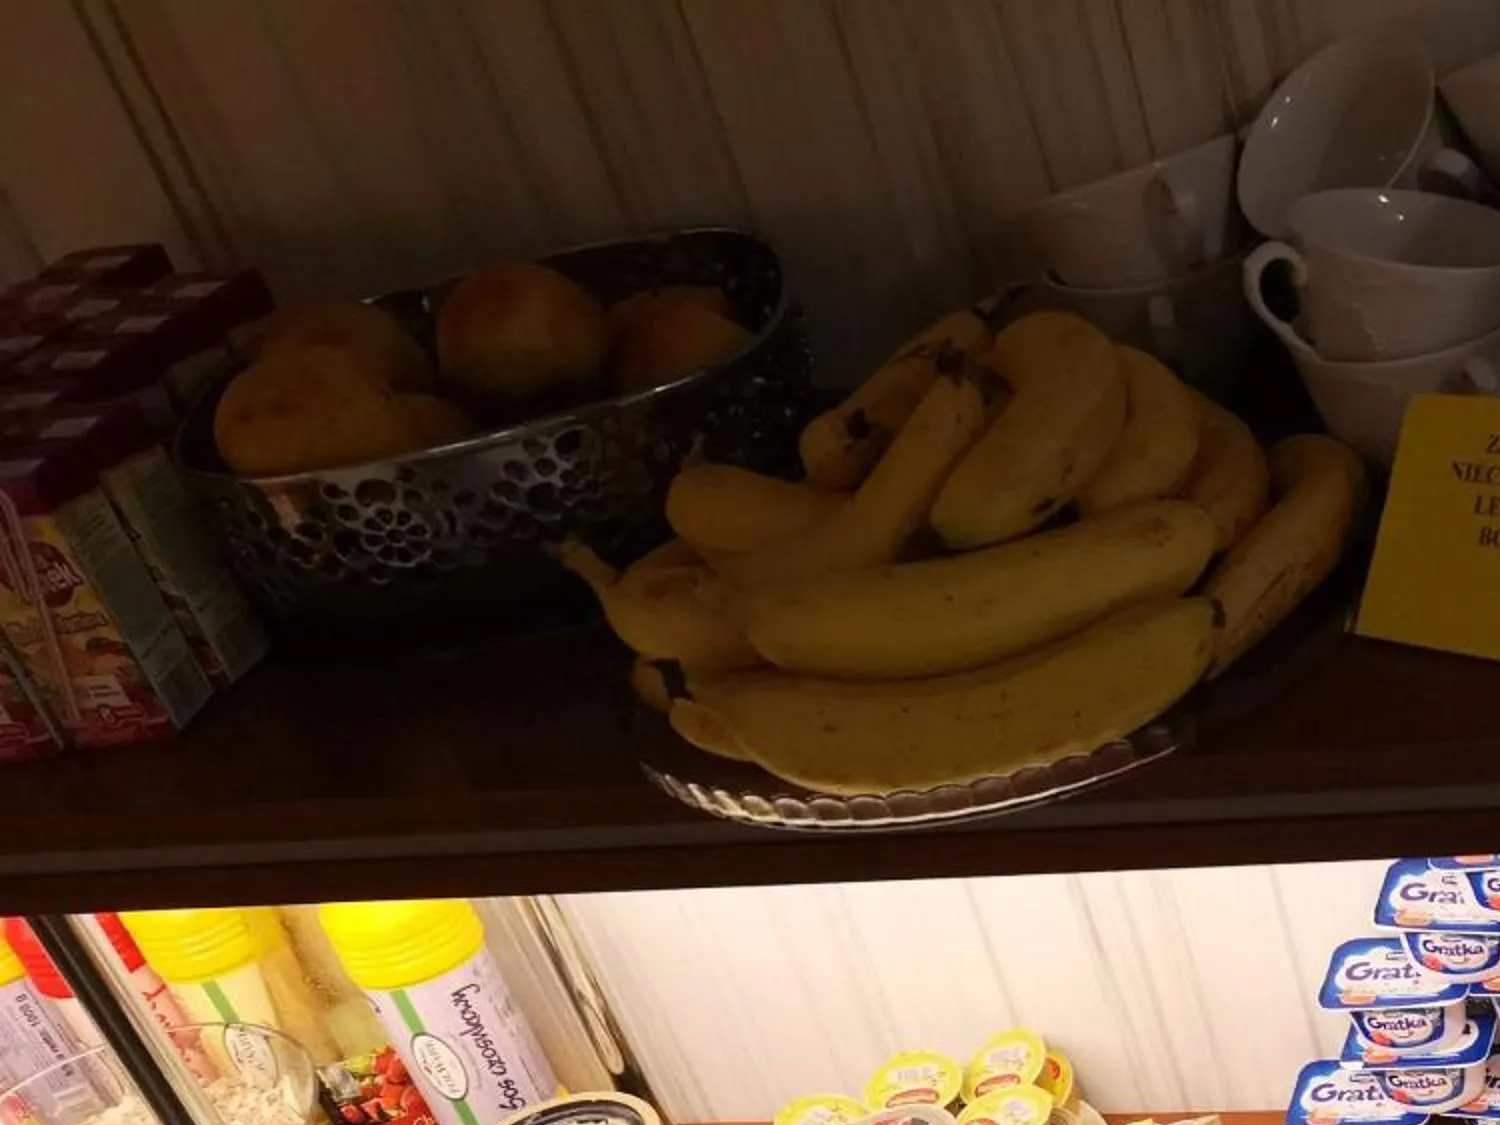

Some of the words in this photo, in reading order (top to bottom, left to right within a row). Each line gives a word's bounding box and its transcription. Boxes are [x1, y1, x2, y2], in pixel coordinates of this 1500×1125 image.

[1422, 939, 1485, 956] Gratka
[1367, 1015, 1427, 1030] Gratka
[1387, 1073, 1448, 1090] Gratka
[498, 1077, 527, 1111] Sos
